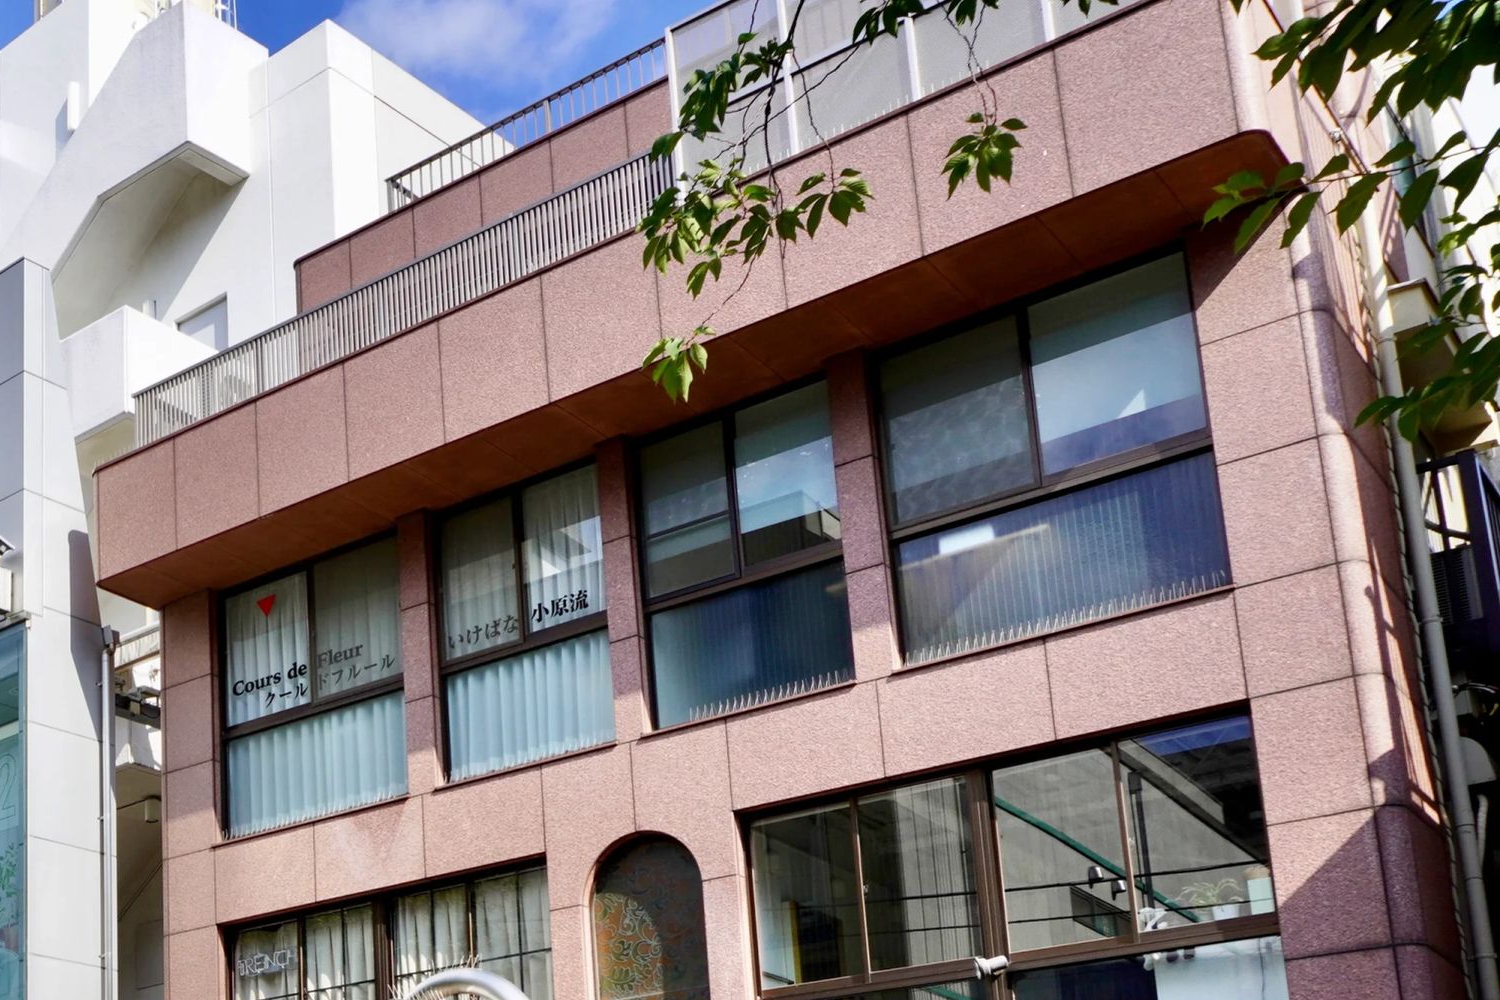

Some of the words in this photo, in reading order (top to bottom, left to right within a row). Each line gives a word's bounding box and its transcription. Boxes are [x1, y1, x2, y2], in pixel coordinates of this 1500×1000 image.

[448, 614, 519, 648] いけばな
[531, 589, 590, 623] 小原流
[232, 672, 281, 696] Cours
[287, 661, 308, 680] de
[316, 644, 364, 669] Fleur
